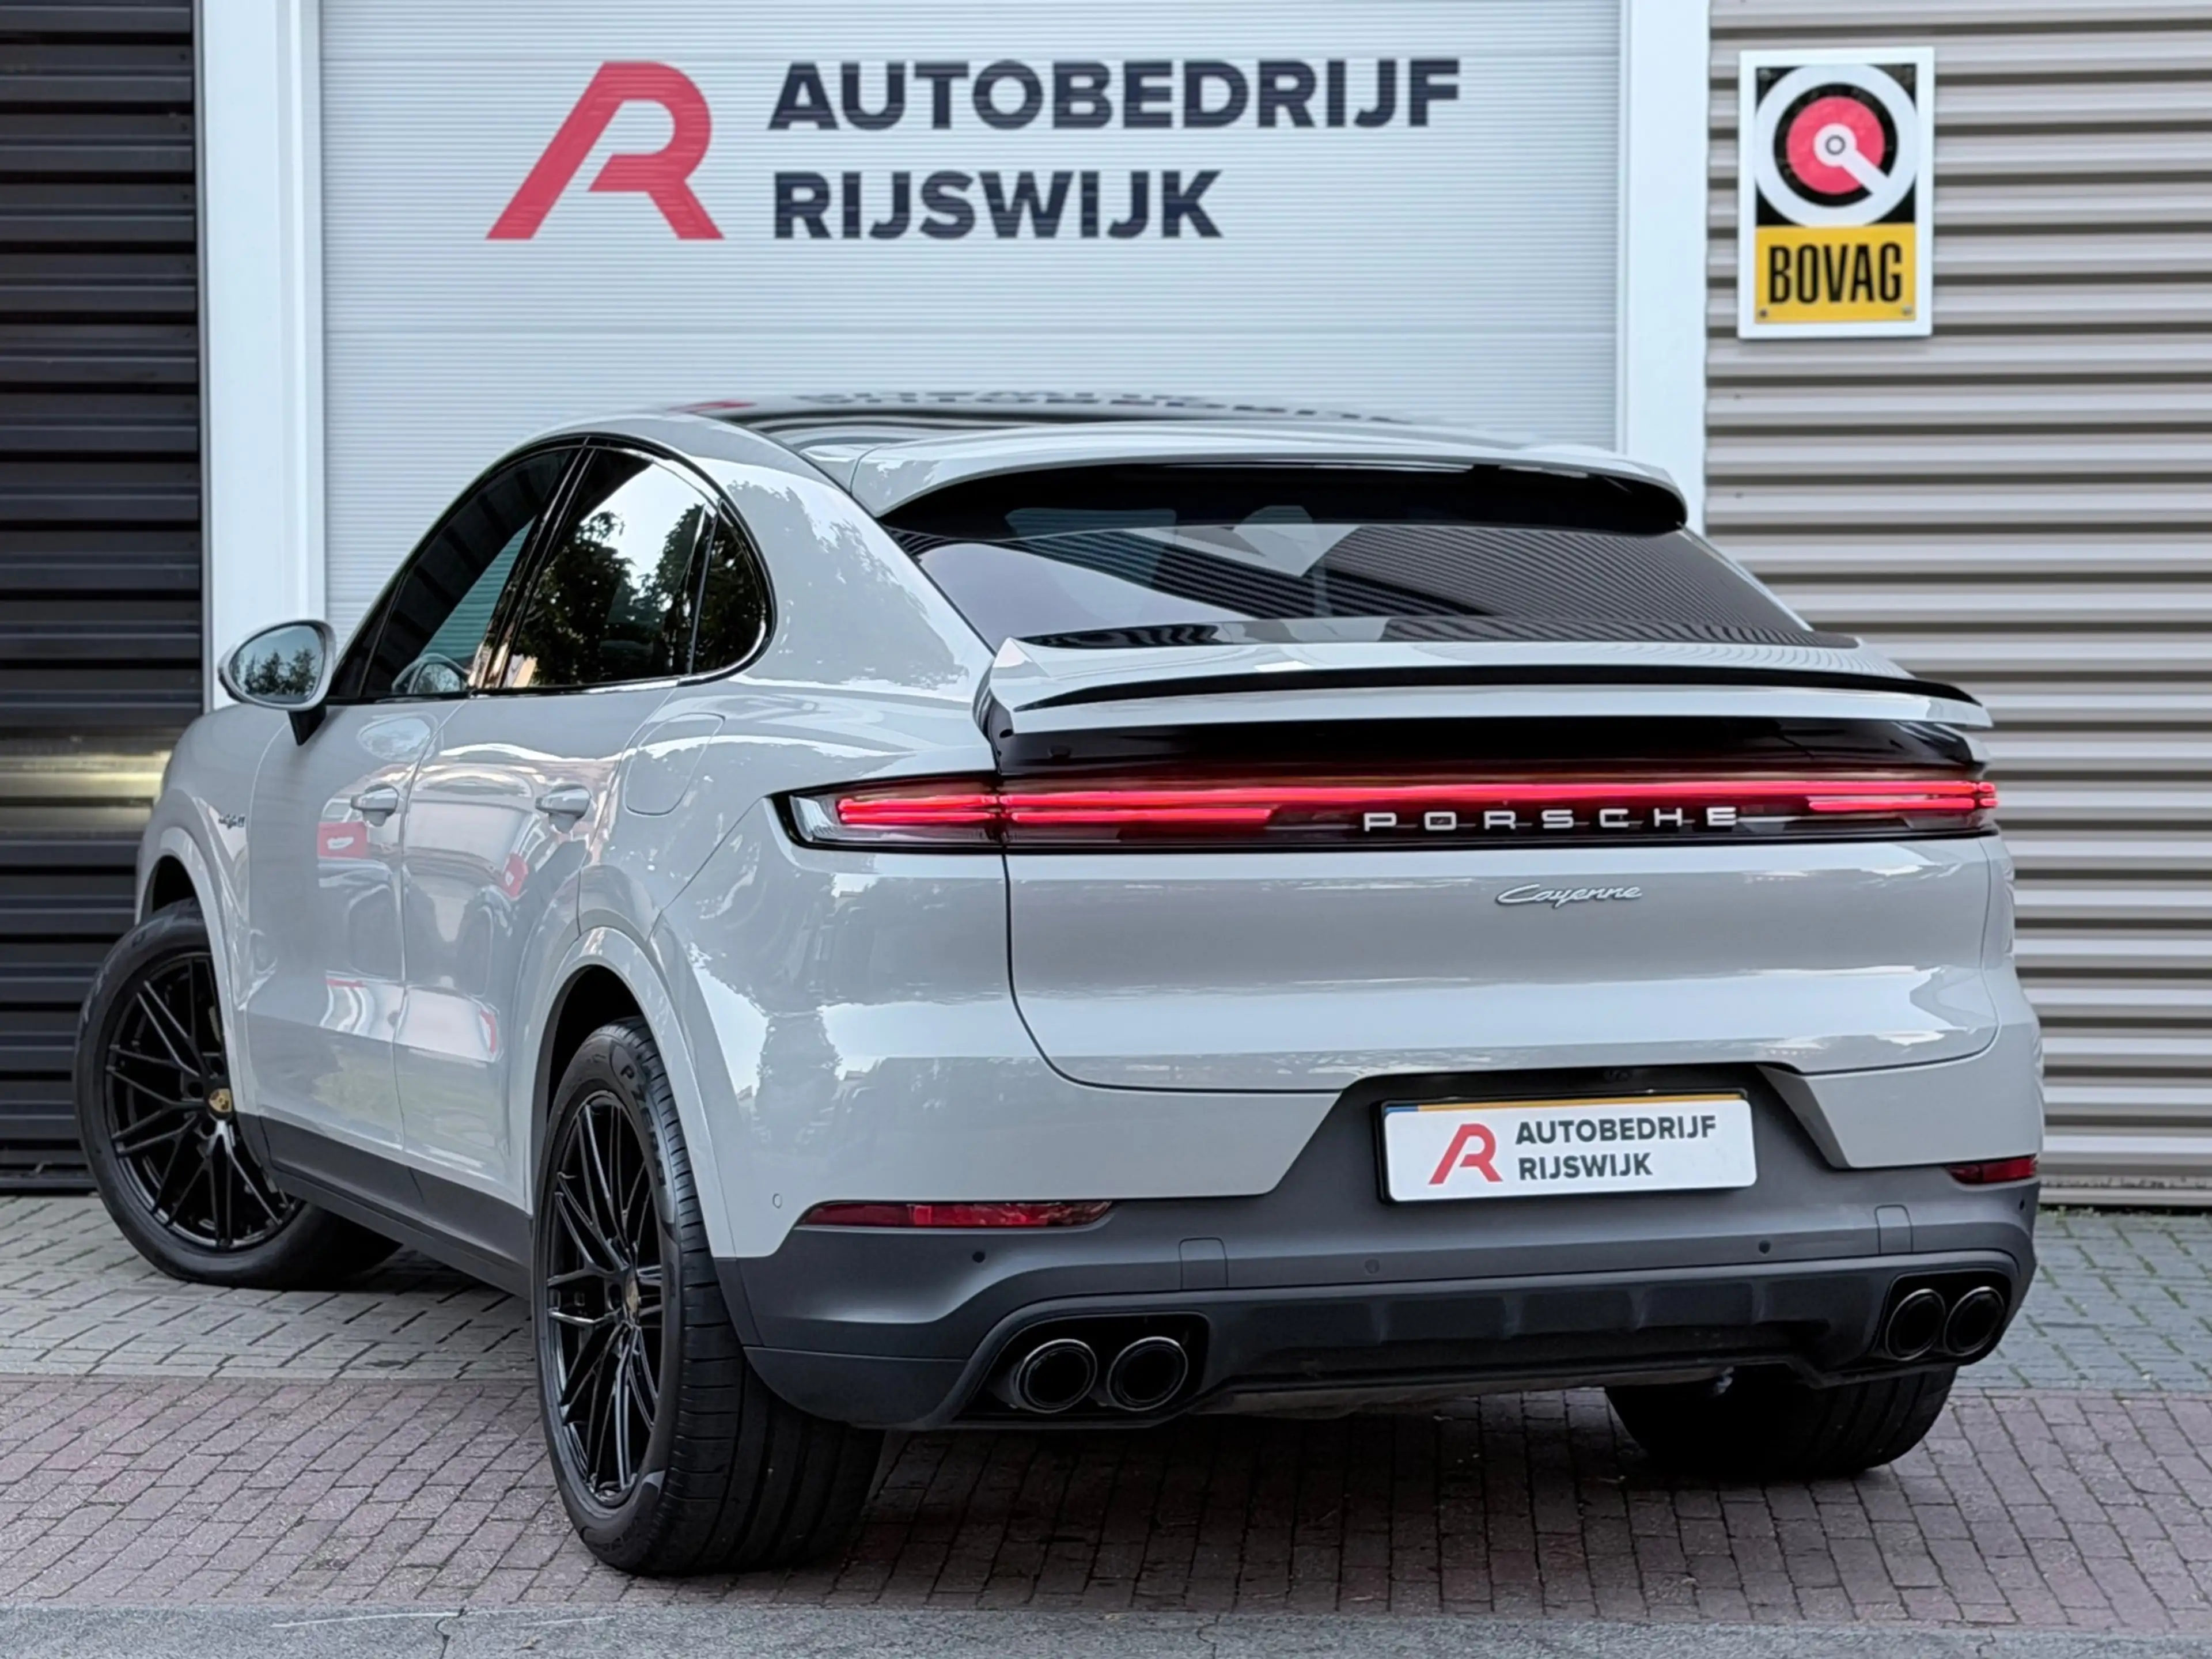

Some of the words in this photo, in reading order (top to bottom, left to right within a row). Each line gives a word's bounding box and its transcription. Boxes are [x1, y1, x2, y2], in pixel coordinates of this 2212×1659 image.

[768, 58, 1460, 131] AUTOBEDRIJF
[774, 170, 1224, 240] RIJSWIJK
[1768, 241, 1903, 304] BOVAG
[1363, 806, 1737, 832] PORSCHE
[1496, 883, 1643, 908] Cayenne
[1515, 1115, 1716, 1145] AUTOBEDRIJF
[1518, 1153, 1653, 1181] RIJSWIJK
